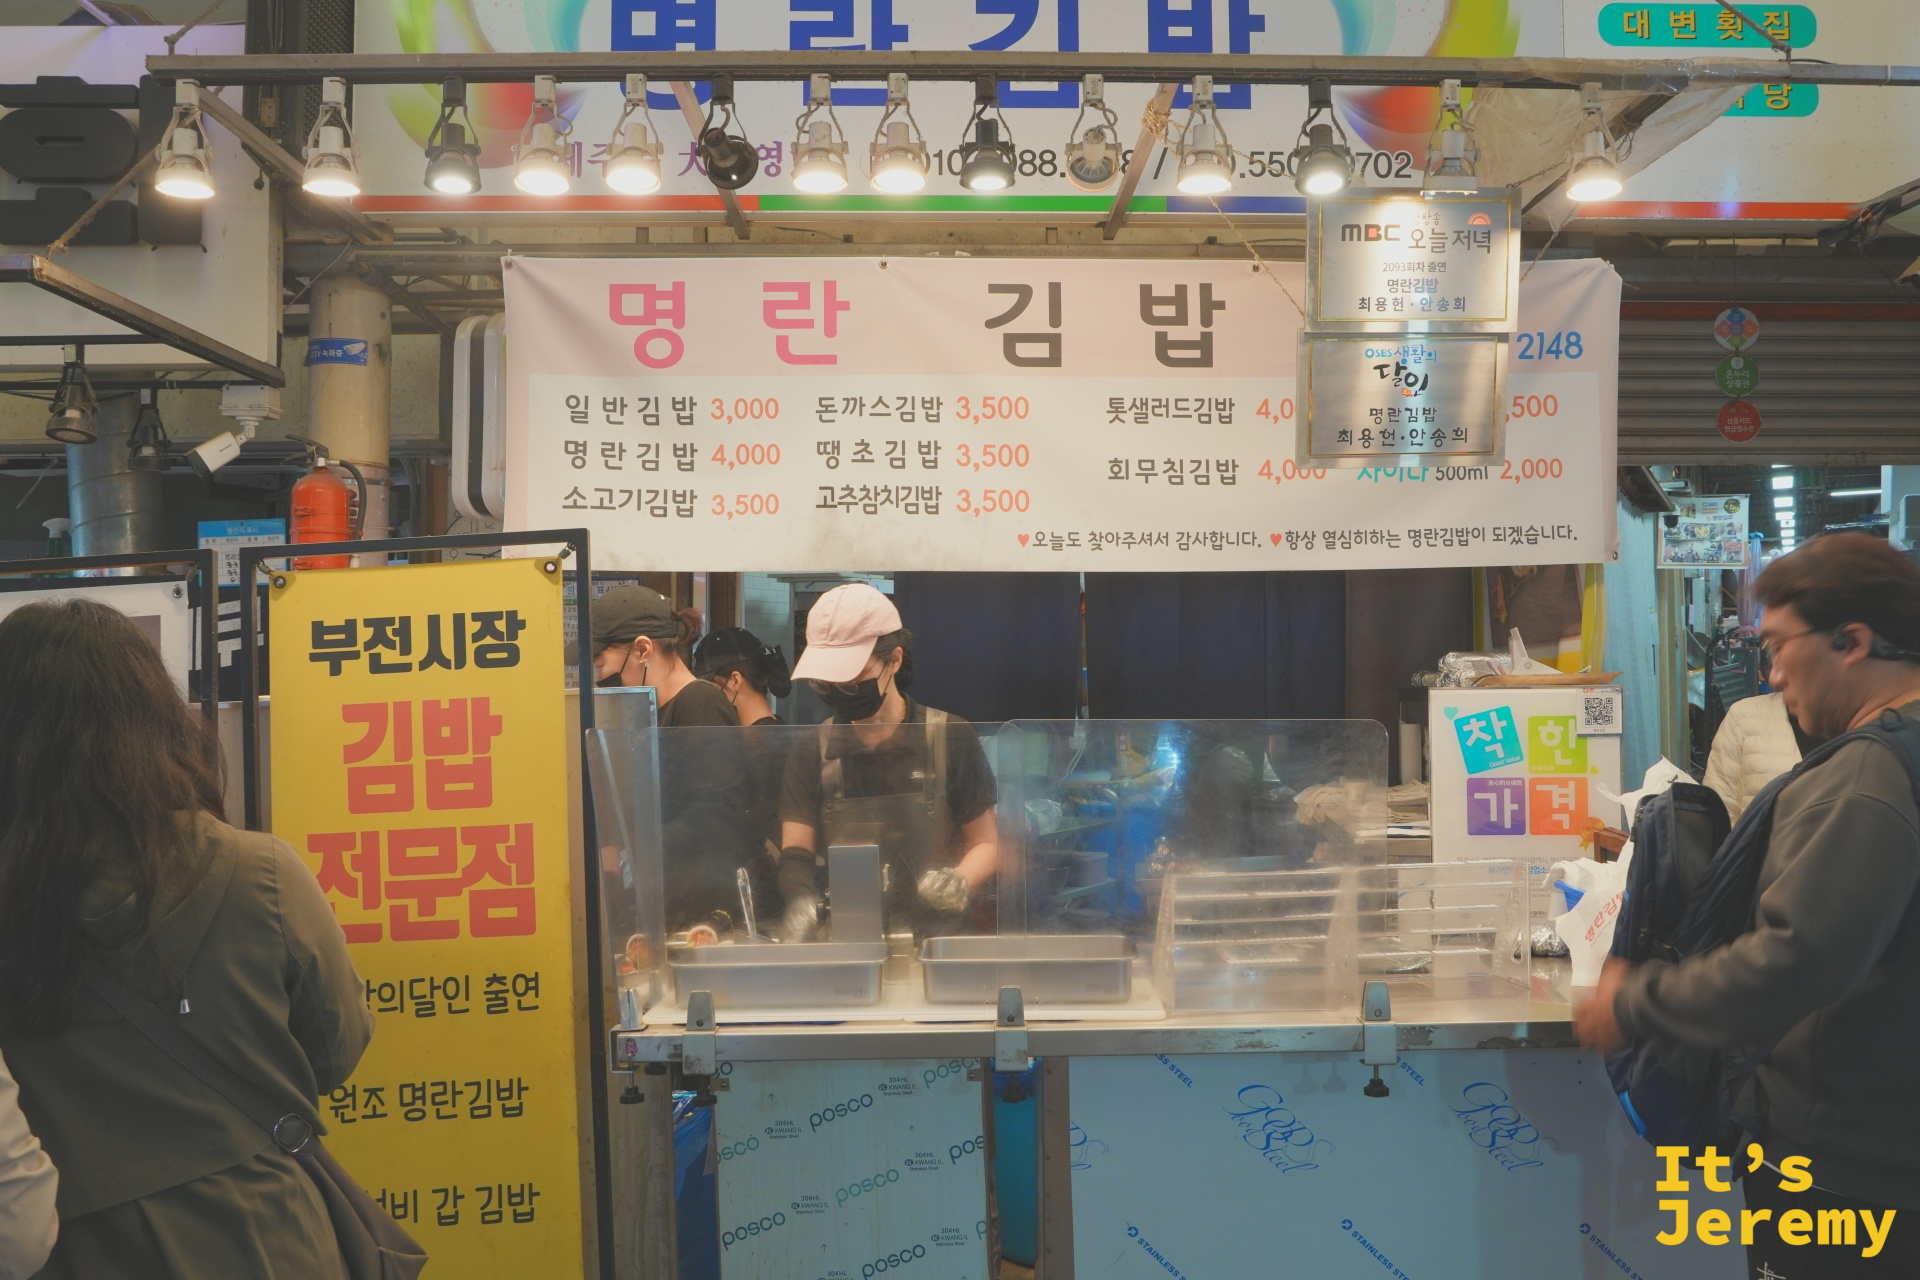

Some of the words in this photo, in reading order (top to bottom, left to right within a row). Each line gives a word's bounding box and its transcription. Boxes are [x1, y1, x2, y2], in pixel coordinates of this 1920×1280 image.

[1623, 10, 1791, 41] 대변횟집
[1341, 224, 1401, 241] MBC
[1382, 262, 1425, 273] 2093회차
[1428, 261, 1447, 273] 출연
[1387, 278, 1439, 294] 명란김밥
[1394, 344, 1437, 365] 생활의
[1373, 361, 1429, 397] 달인
[1726, 370, 1749, 379] 온누리
[1726, 379, 1750, 389] 상품권
[564, 394, 699, 426] 일반김밥
[710, 397, 780, 424] 3,000
[815, 395, 944, 424] 돈까스김밥
[955, 395, 1030, 425] 3,500
[1107, 396, 1236, 426] 톳샐러드김밥
[1256, 398, 1297, 424] 4,0
[1369, 407, 1437, 425] 명란김밥
[1505, 394, 1559, 424] ,500
[1726, 417, 1752, 425] 신용카드
[563, 439, 699, 472] 명란김밥
[711, 443, 781, 470] 4,000
[816, 438, 942, 471] 땡초김밥
[955, 443, 1030, 471] 3,500
[1108, 457, 1240, 486] 회무침김밥
[1258, 459, 1327, 485] 4,000
[1435, 465, 1489, 482] 500ml
[1500, 458, 1564, 484] 2,000
[562, 486, 699, 519] 소고기김밥
[711, 493, 780, 520] 3,500
[815, 484, 943, 516] 고추참치김밥
[955, 488, 1030, 516] 3,500
[247, 526, 259, 534] 표시
[1033, 530, 1083, 550] 오늘도
[1088, 530, 1170, 552] 찾아주셔서
[1176, 529, 1262, 551] 감사합니다.
[1285, 529, 1317, 552] 항상
[1322, 528, 1402, 551] 열심히하는
[1407, 527, 1487, 549] 명란김밥이
[1492, 524, 1578, 546] 되겠습니다.
[308, 609, 527, 677] 부전시장
[341, 696, 503, 815] 김밥
[1489, 757, 1504, 768] Good
[306, 822, 537, 945] 전문점
[483, 972, 540, 1015] 출연
[1169, 1063, 1194, 1088] STEEL
[1400, 1062, 1425, 1086] STEEL
[329, 1084, 388, 1124] 원조
[399, 1077, 530, 1122] 명란김밥
[809, 1093, 873, 1133] posco
[949, 1135, 984, 1165] pos
[835, 1168, 899, 1208] posco
[431, 1186, 466, 1226] 갑
[475, 1183, 541, 1225] 김밥
[722, 1212, 785, 1251] posco
[862, 1244, 925, 1280] posco
[1137, 1237, 1180, 1277] STAINLESS
[1351, 1230, 1394, 1270] STAINLESS
[1589, 1234, 1632, 1274] STAINLESS
